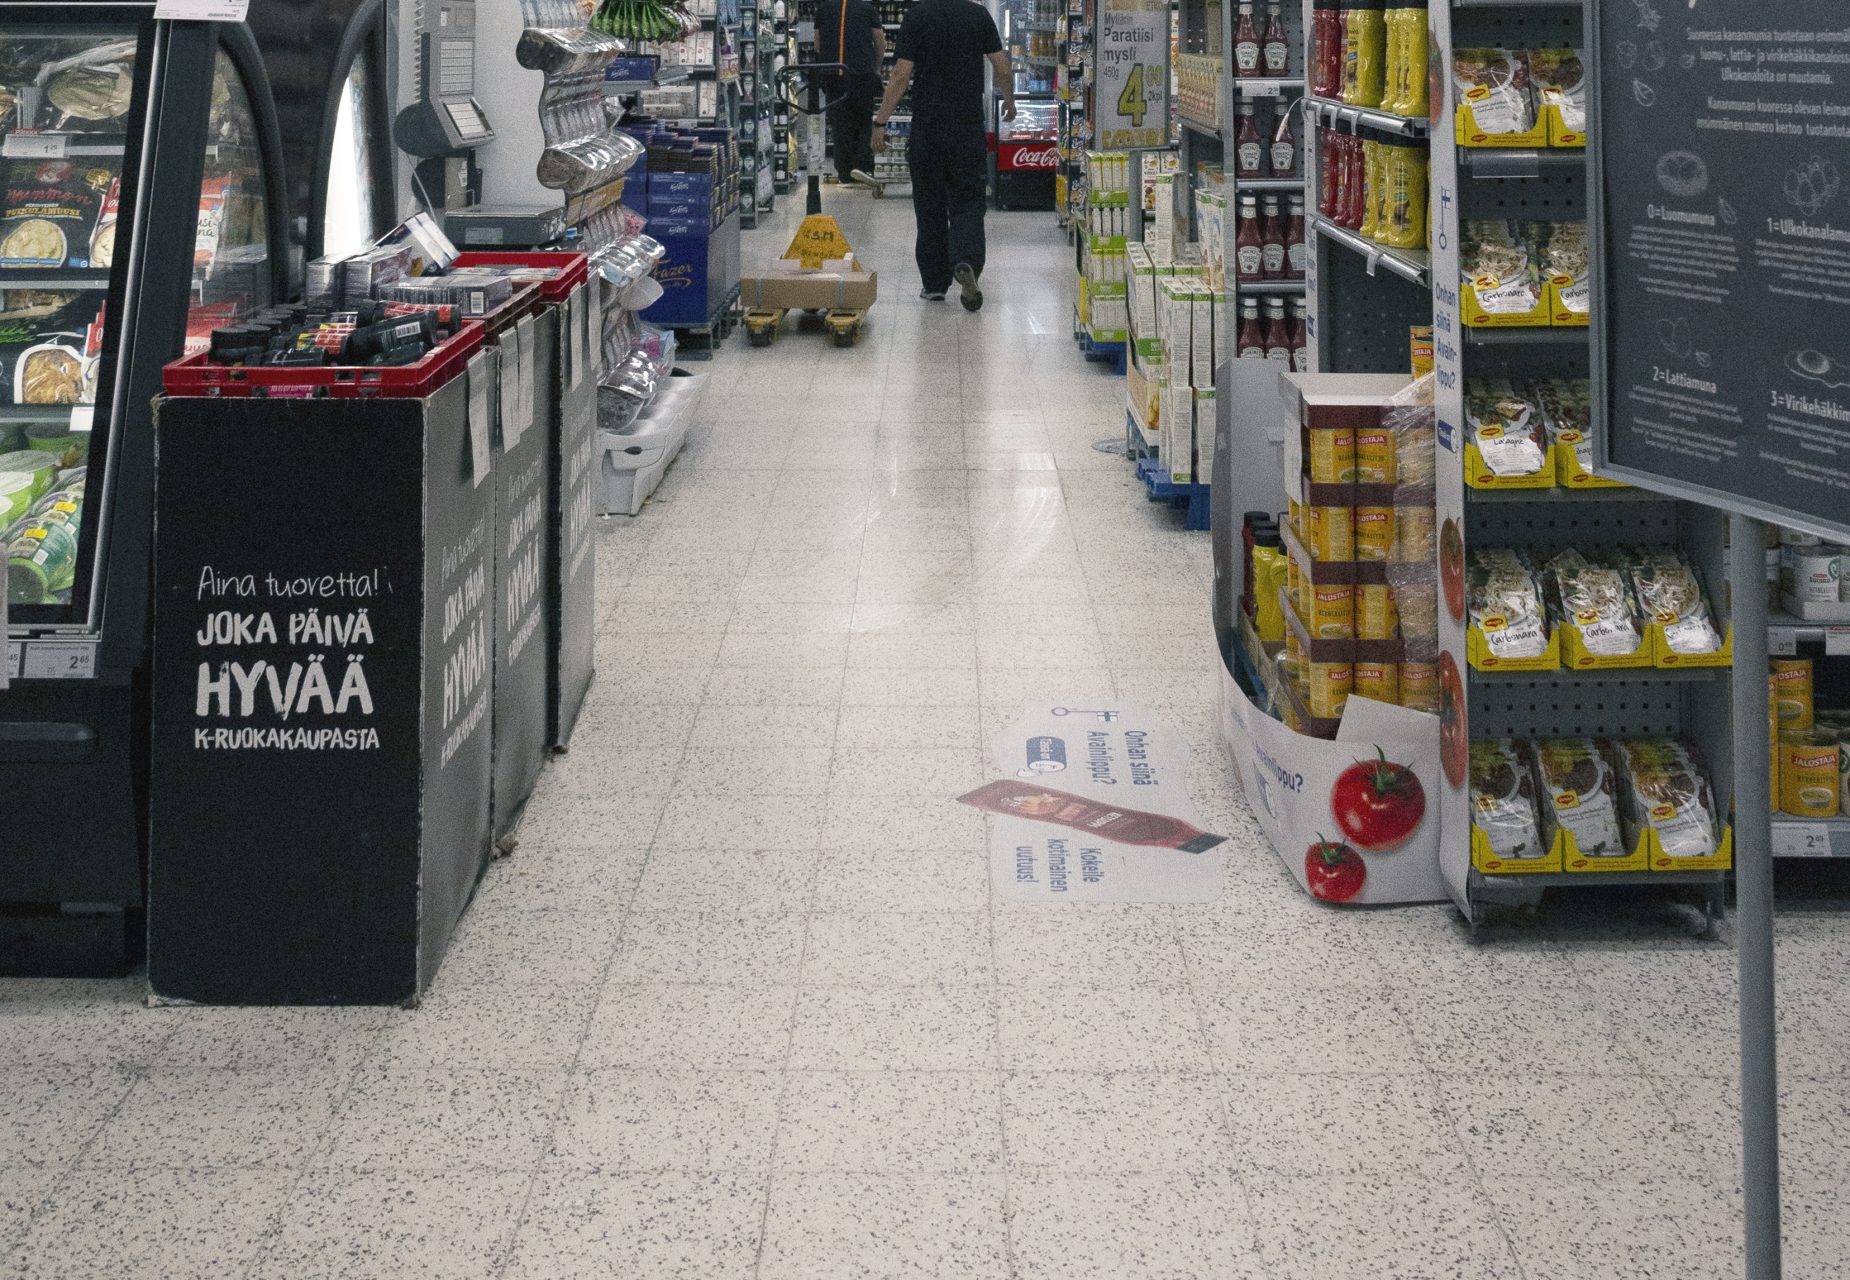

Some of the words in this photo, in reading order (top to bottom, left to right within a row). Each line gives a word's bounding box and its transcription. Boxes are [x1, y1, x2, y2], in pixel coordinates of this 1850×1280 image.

[1104, 27, 1154, 43] Paratiisi
[1104, 47, 1137, 65] mysli
[1435, 282, 1456, 308] Onhan
[1560, 287, 1590, 299] Carbon
[199, 566, 256, 600] Aina
[265, 569, 379, 598] tuoretta!
[197, 610, 278, 646] JOKA
[290, 607, 374, 648] PÄIVÄ
[1491, 630, 1538, 646] Carbonara
[196, 653, 374, 721] HYVÄÄ
[194, 727, 380, 751] K-RUOKAKAUPASTA
[1125, 730, 1149, 760] Onhan
[1087, 730, 1118, 786] Avainlippu?
[1130, 761, 1158, 786] siinä
[1016, 846, 1039, 883] uutuus!
[1048, 838, 1068, 892] kotimainen
[1080, 847, 1105, 883] Kokeile
